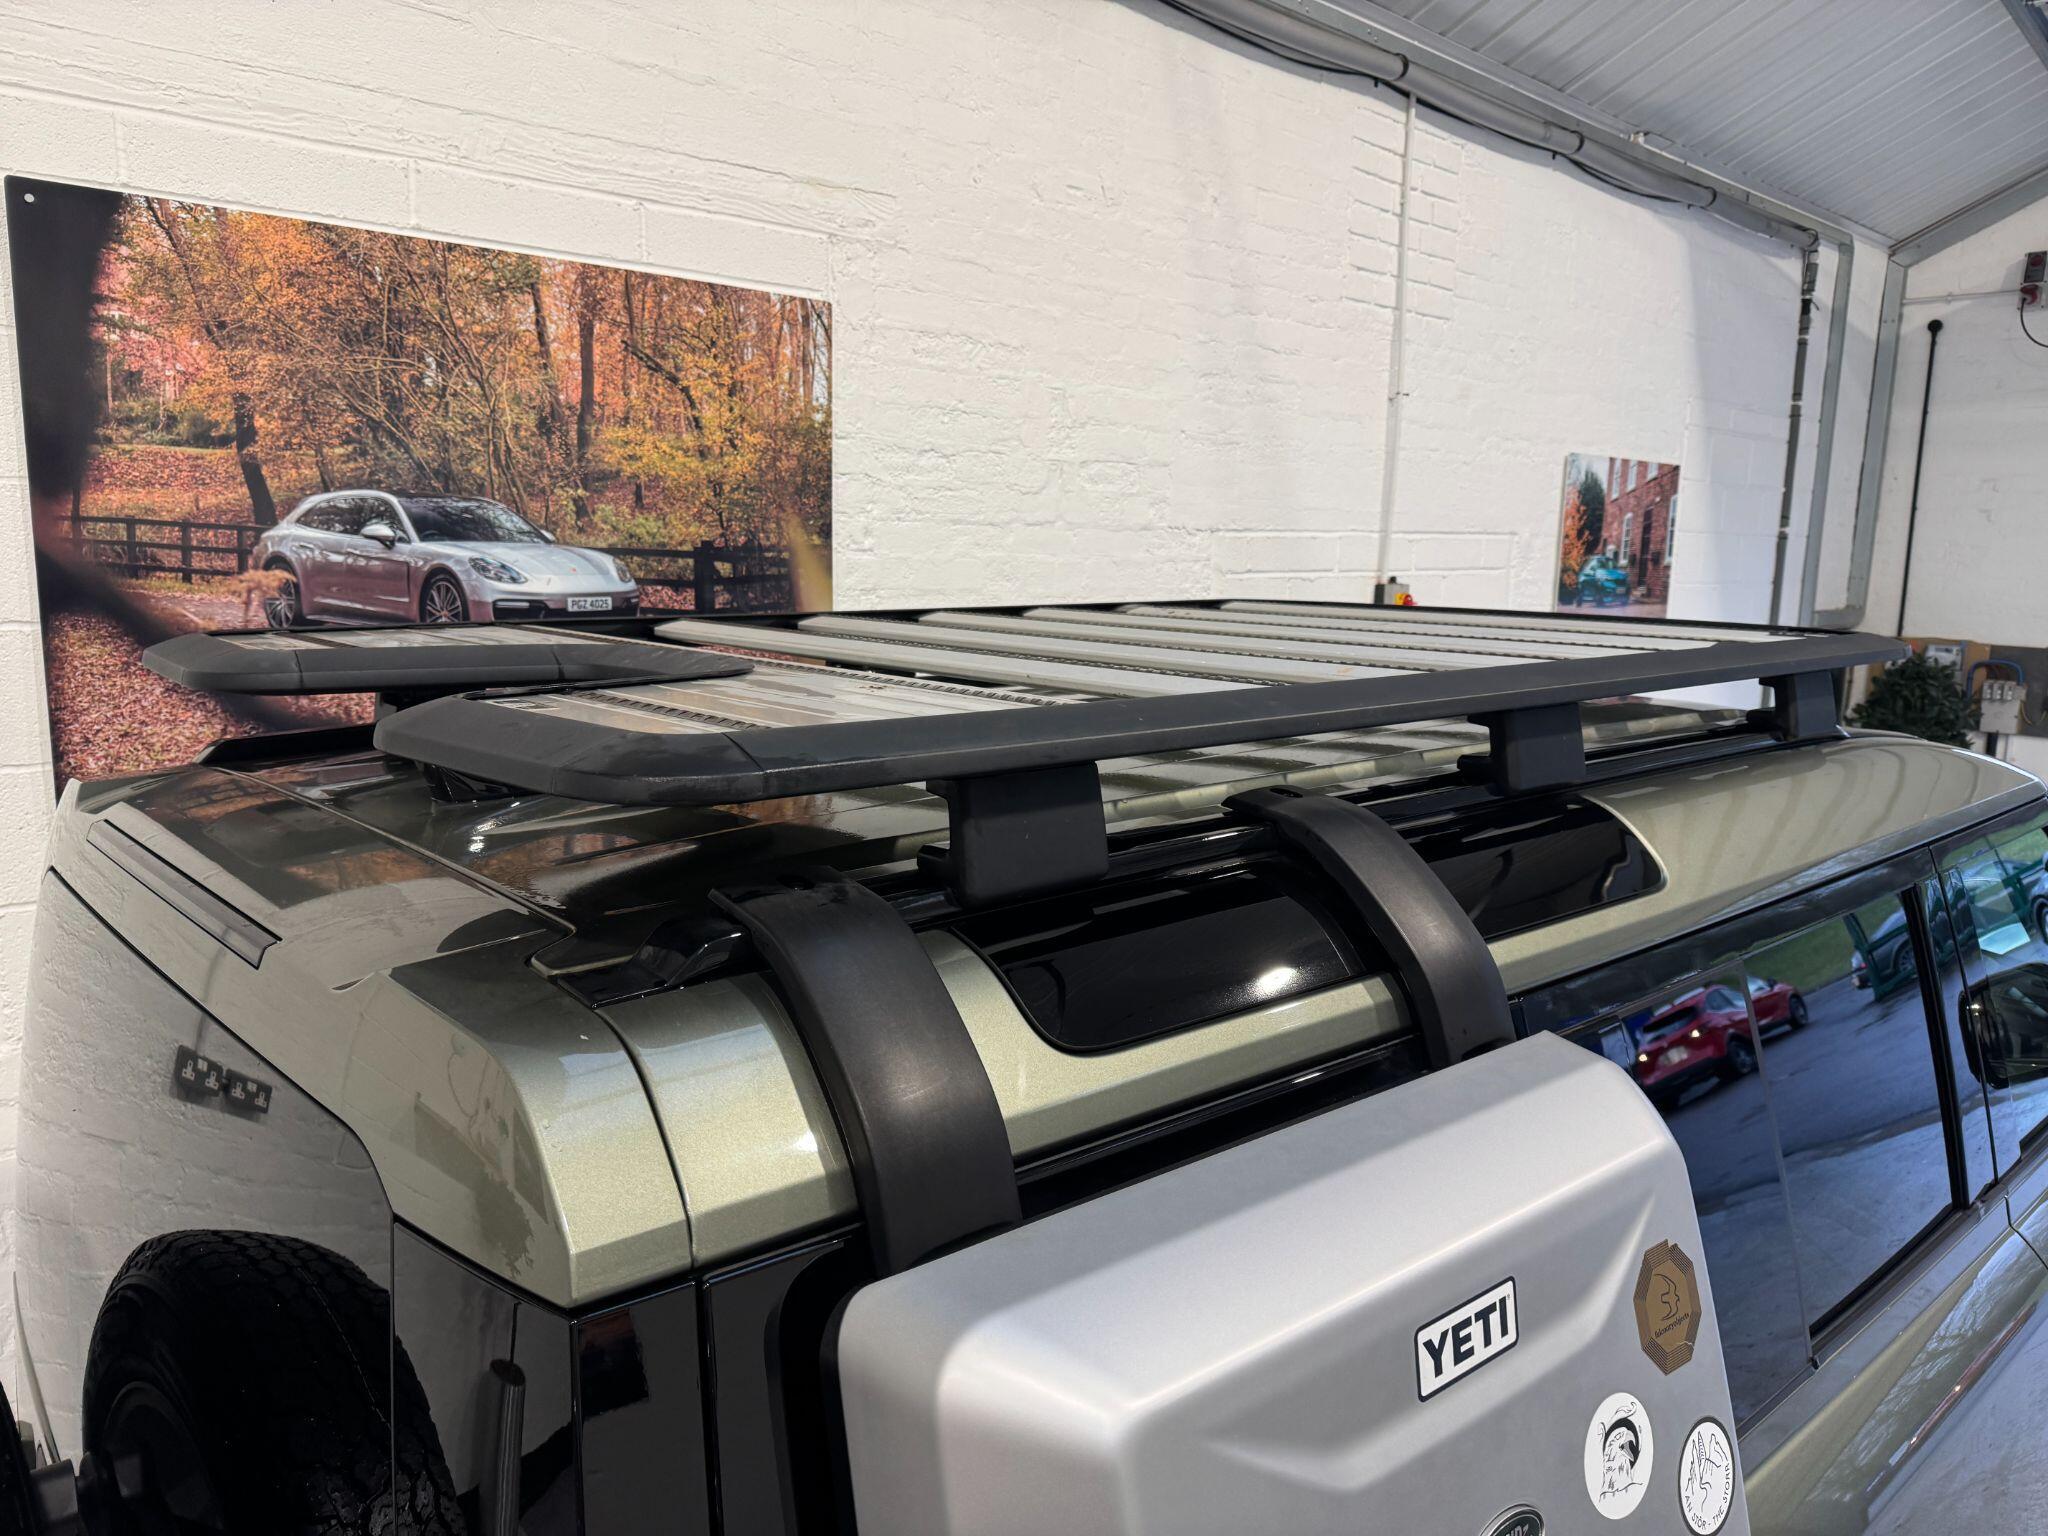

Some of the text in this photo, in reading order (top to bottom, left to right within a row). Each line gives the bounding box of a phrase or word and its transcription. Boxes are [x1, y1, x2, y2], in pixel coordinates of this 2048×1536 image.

[571, 599, 610, 609] PGZ 4025
[1422, 1295, 1509, 1379] YETI
[1685, 1495, 1693, 1513] AN
[1712, 1505, 1725, 1526] THE
